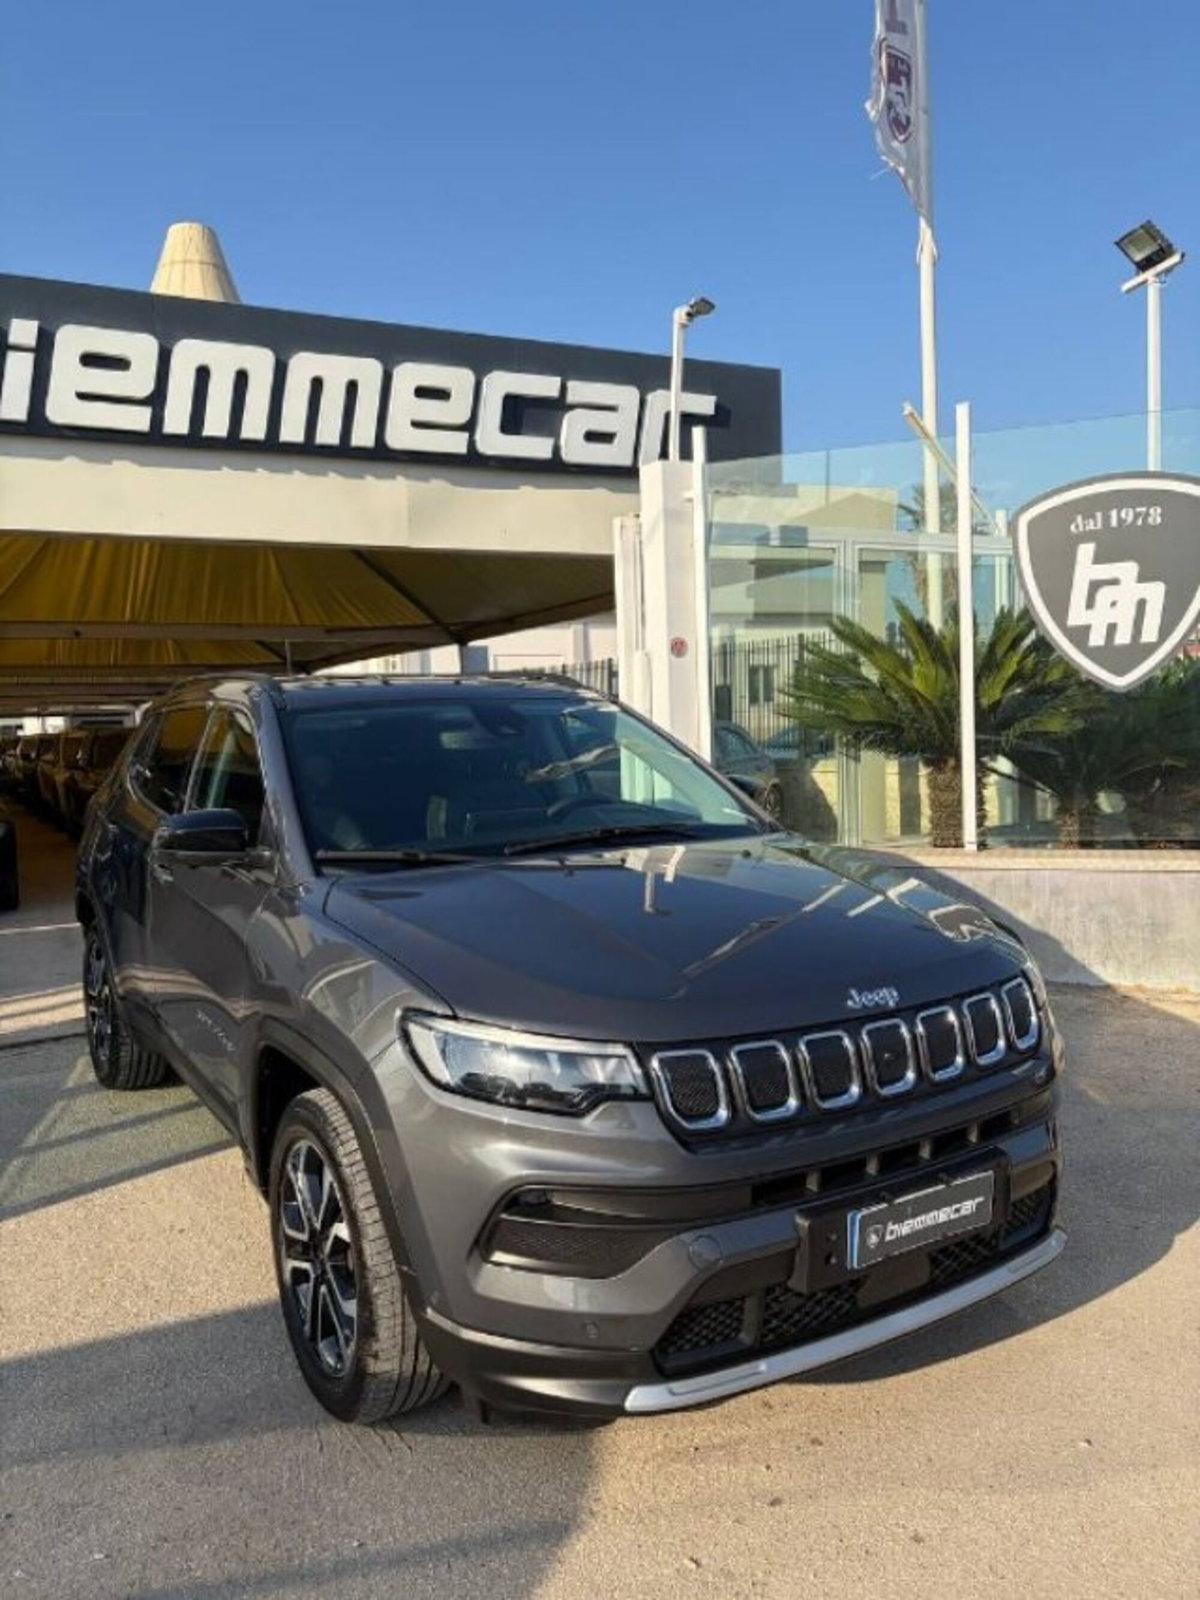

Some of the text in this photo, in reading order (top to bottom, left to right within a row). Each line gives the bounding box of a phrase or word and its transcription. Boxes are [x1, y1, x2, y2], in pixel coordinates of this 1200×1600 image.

[1070, 506, 1162, 533] dal 1978
[847, 987, 899, 1009] Jeep
[884, 1197, 985, 1242] biemmecar
